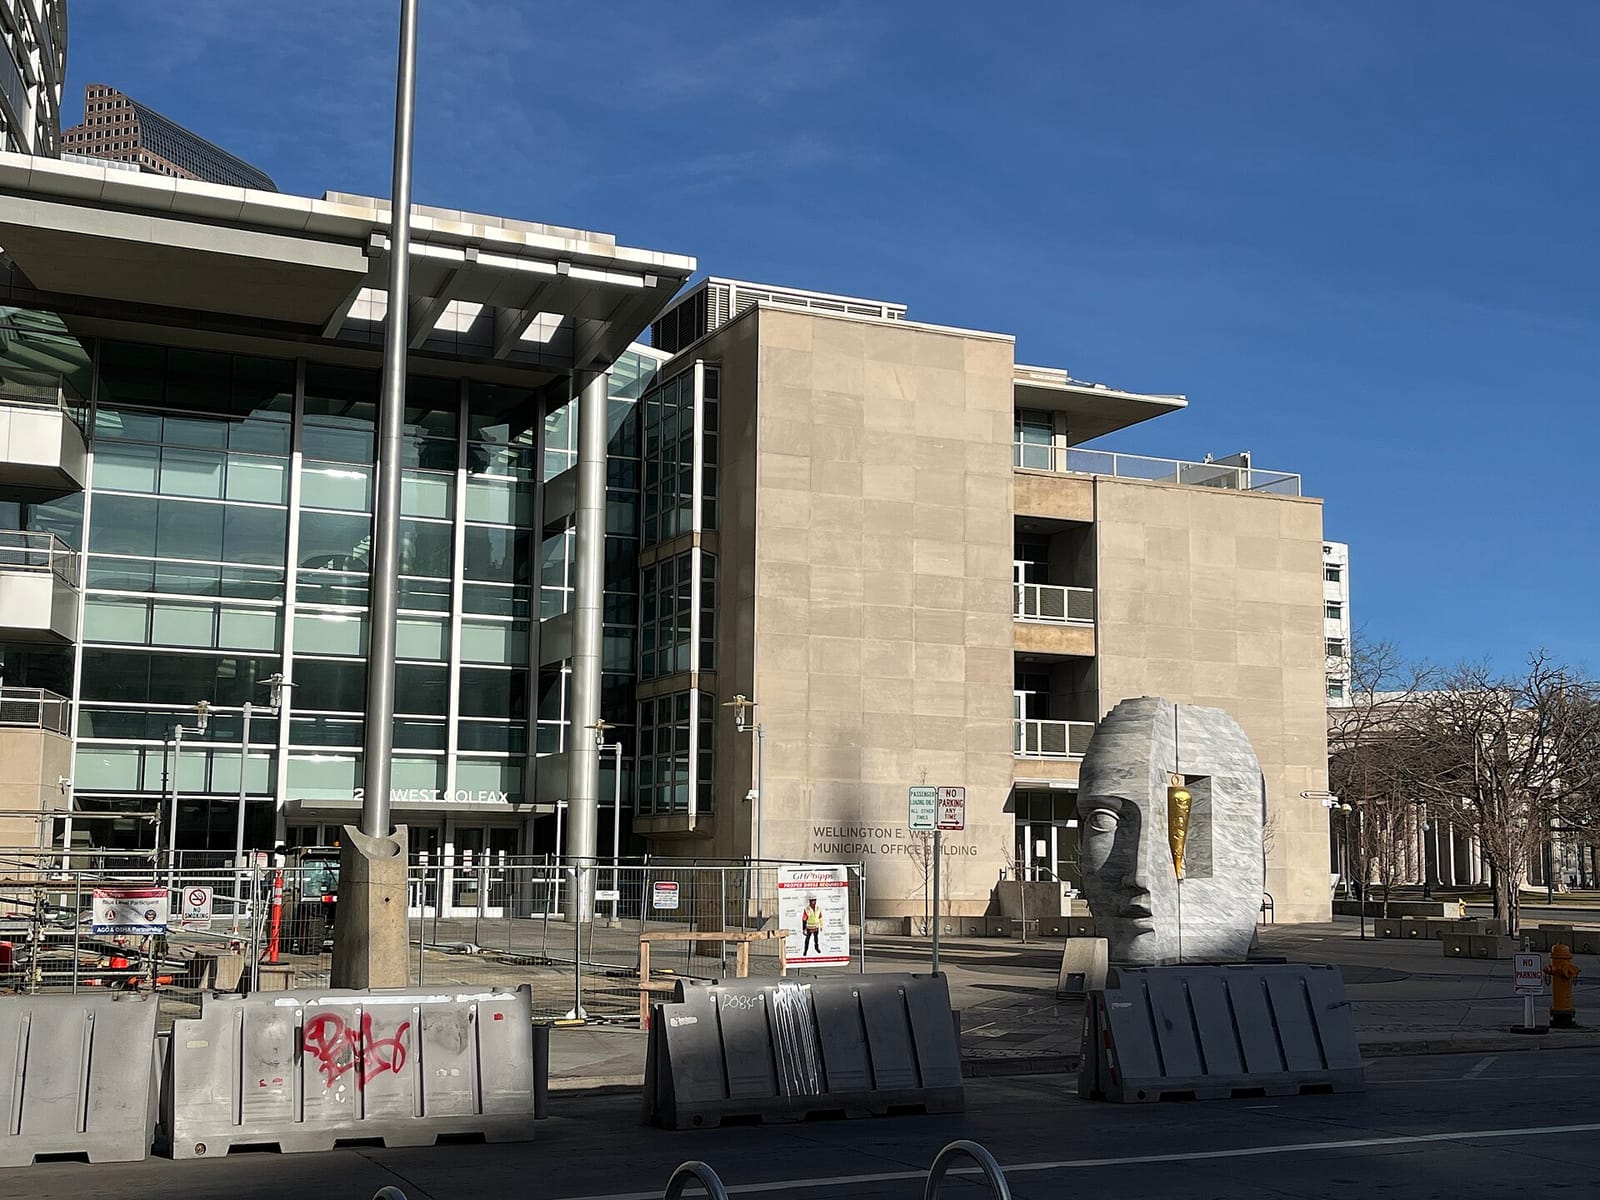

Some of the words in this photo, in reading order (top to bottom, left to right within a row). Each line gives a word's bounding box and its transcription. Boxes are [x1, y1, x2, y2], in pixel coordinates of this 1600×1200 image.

[390, 788, 440, 801] WEST
[945, 789, 957, 797] NO
[938, 799, 963, 807] PARKING
[813, 827, 892, 839] WELLINGTON
[895, 828, 906, 839] E.
[813, 843, 876, 854] MUNICIPAL
[880, 844, 921, 855] OFFICE
[926, 845, 977, 856] BILDING
[132, 925, 164, 934] Partnership
[1522, 958, 1534, 967] NO
[1515, 971, 1542, 979] PARKING
